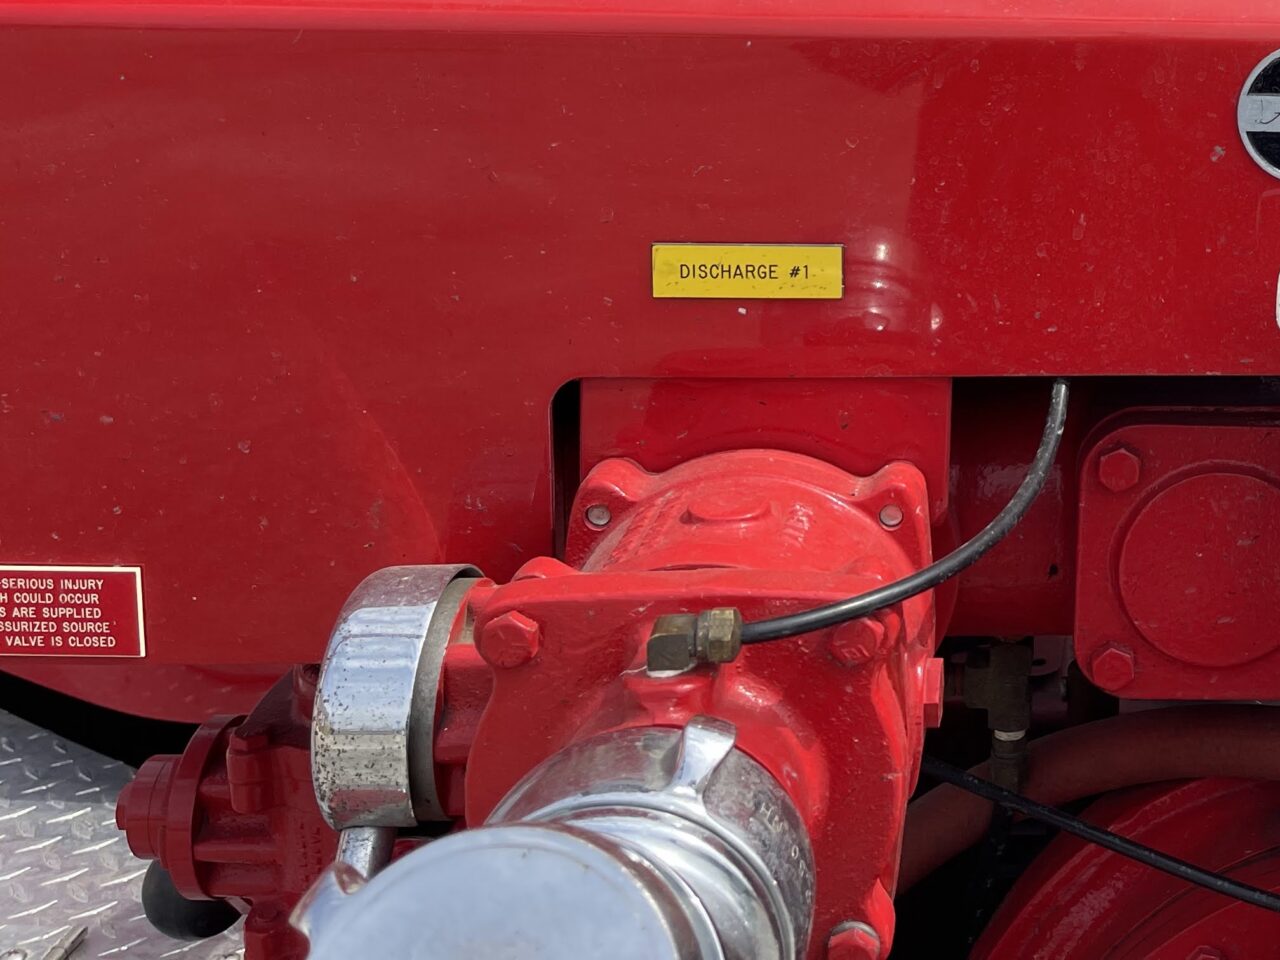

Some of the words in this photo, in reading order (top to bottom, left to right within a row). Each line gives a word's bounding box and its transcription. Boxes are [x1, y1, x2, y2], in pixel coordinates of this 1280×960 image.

[679, 264, 778, 279] DISCHARGE
[789, 265, 809, 279] #1
[60, 579, 104, 590] INJURY
[14, 593, 54, 604] COULD
[59, 594, 99, 604] OCCUR
[12, 607, 36, 618] ARE
[42, 608, 102, 619] SUPPLIED
[63, 622, 110, 633] SOURCE
[6, 636, 45, 647] VALVE
[51, 636, 63, 647] IS
[68, 637, 116, 647] CLOSED
